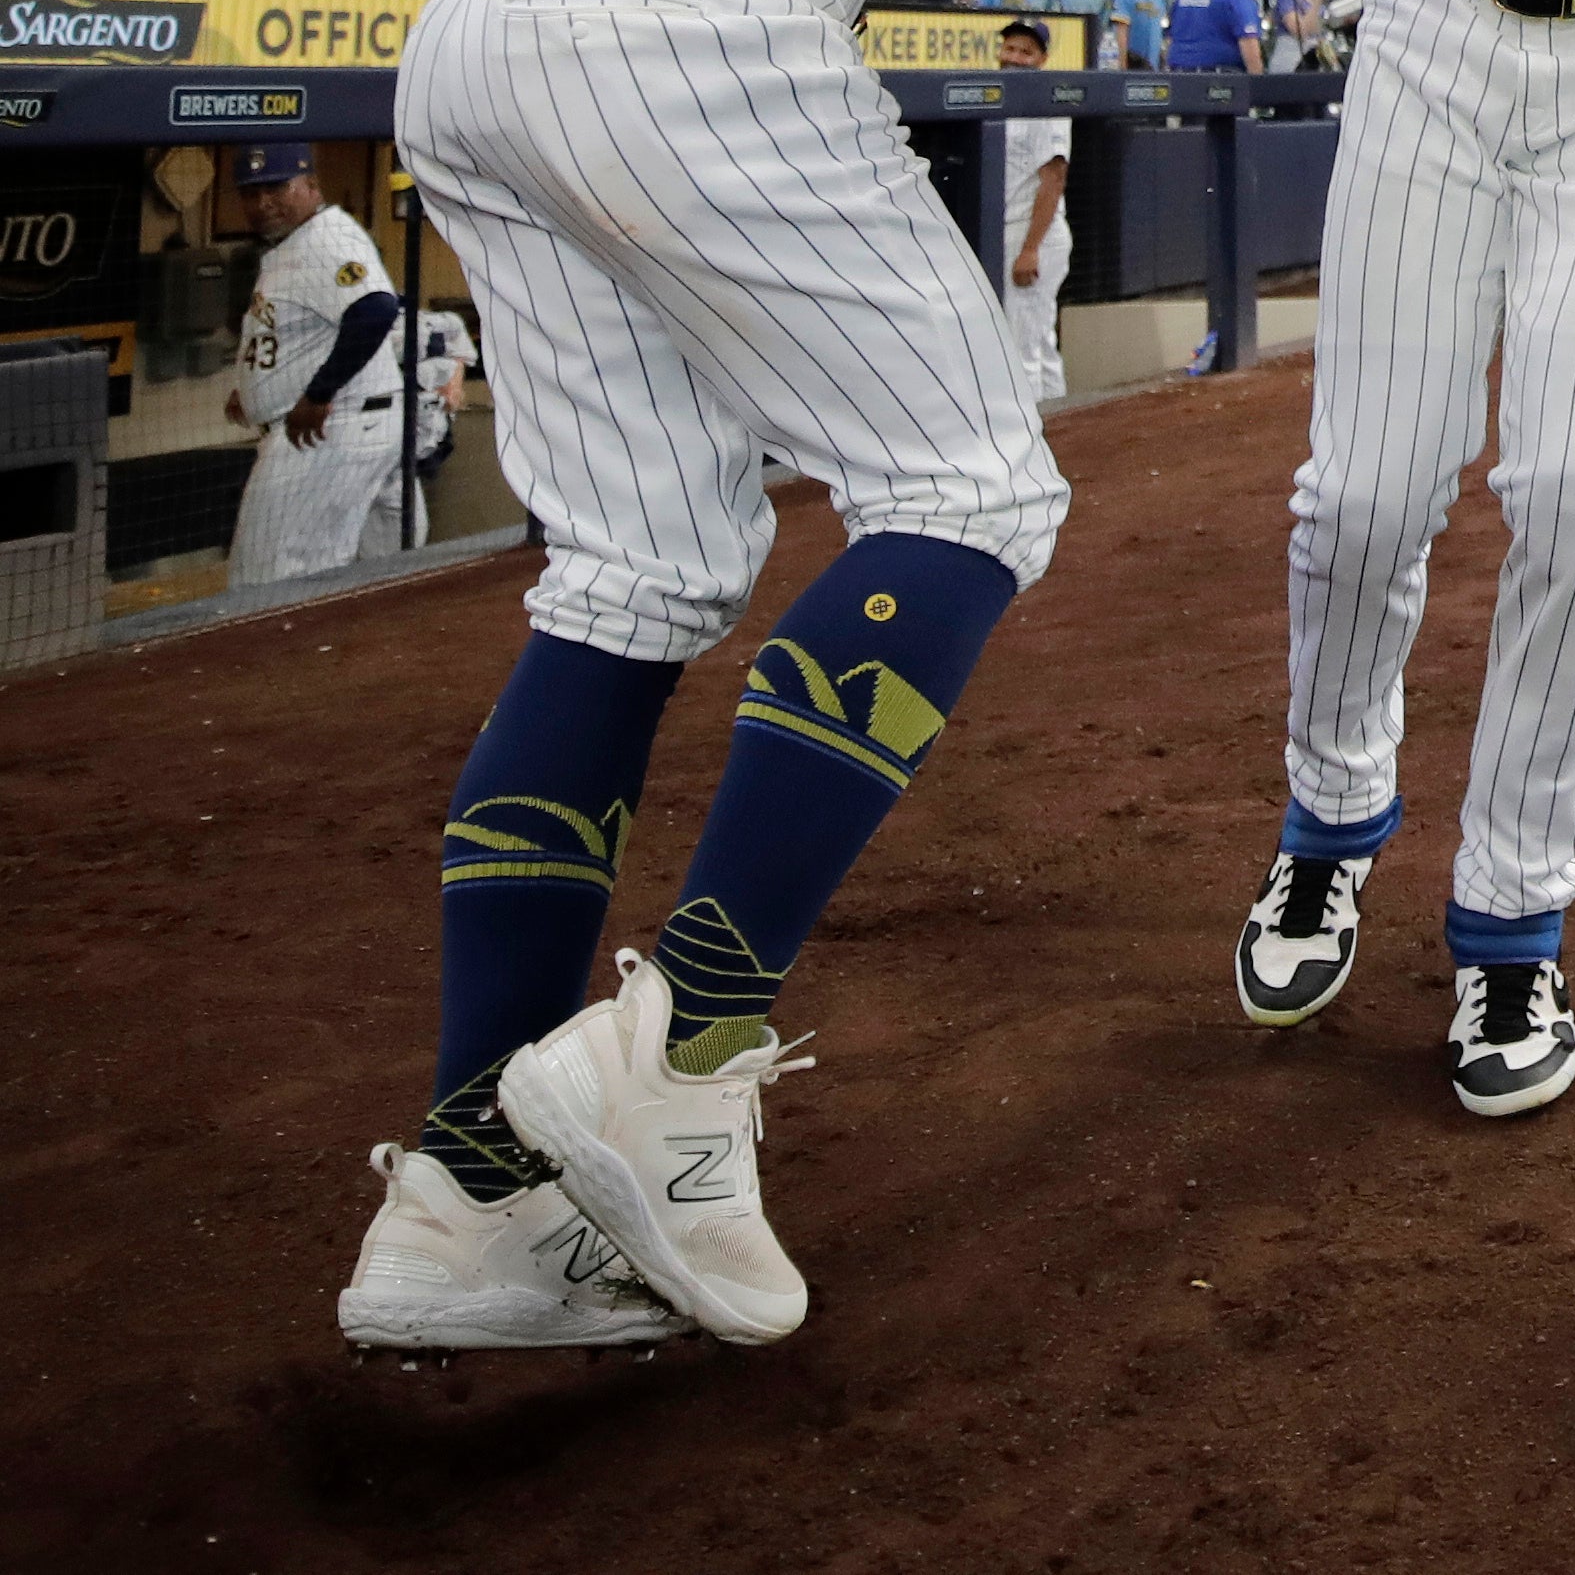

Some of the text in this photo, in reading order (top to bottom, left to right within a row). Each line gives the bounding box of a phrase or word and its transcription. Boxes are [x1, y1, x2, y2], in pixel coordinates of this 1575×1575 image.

[0, 0, 178, 52] SARGENTO
[179, 94, 298, 117] BREWERS.COM
[243, 335, 279, 370] 43
